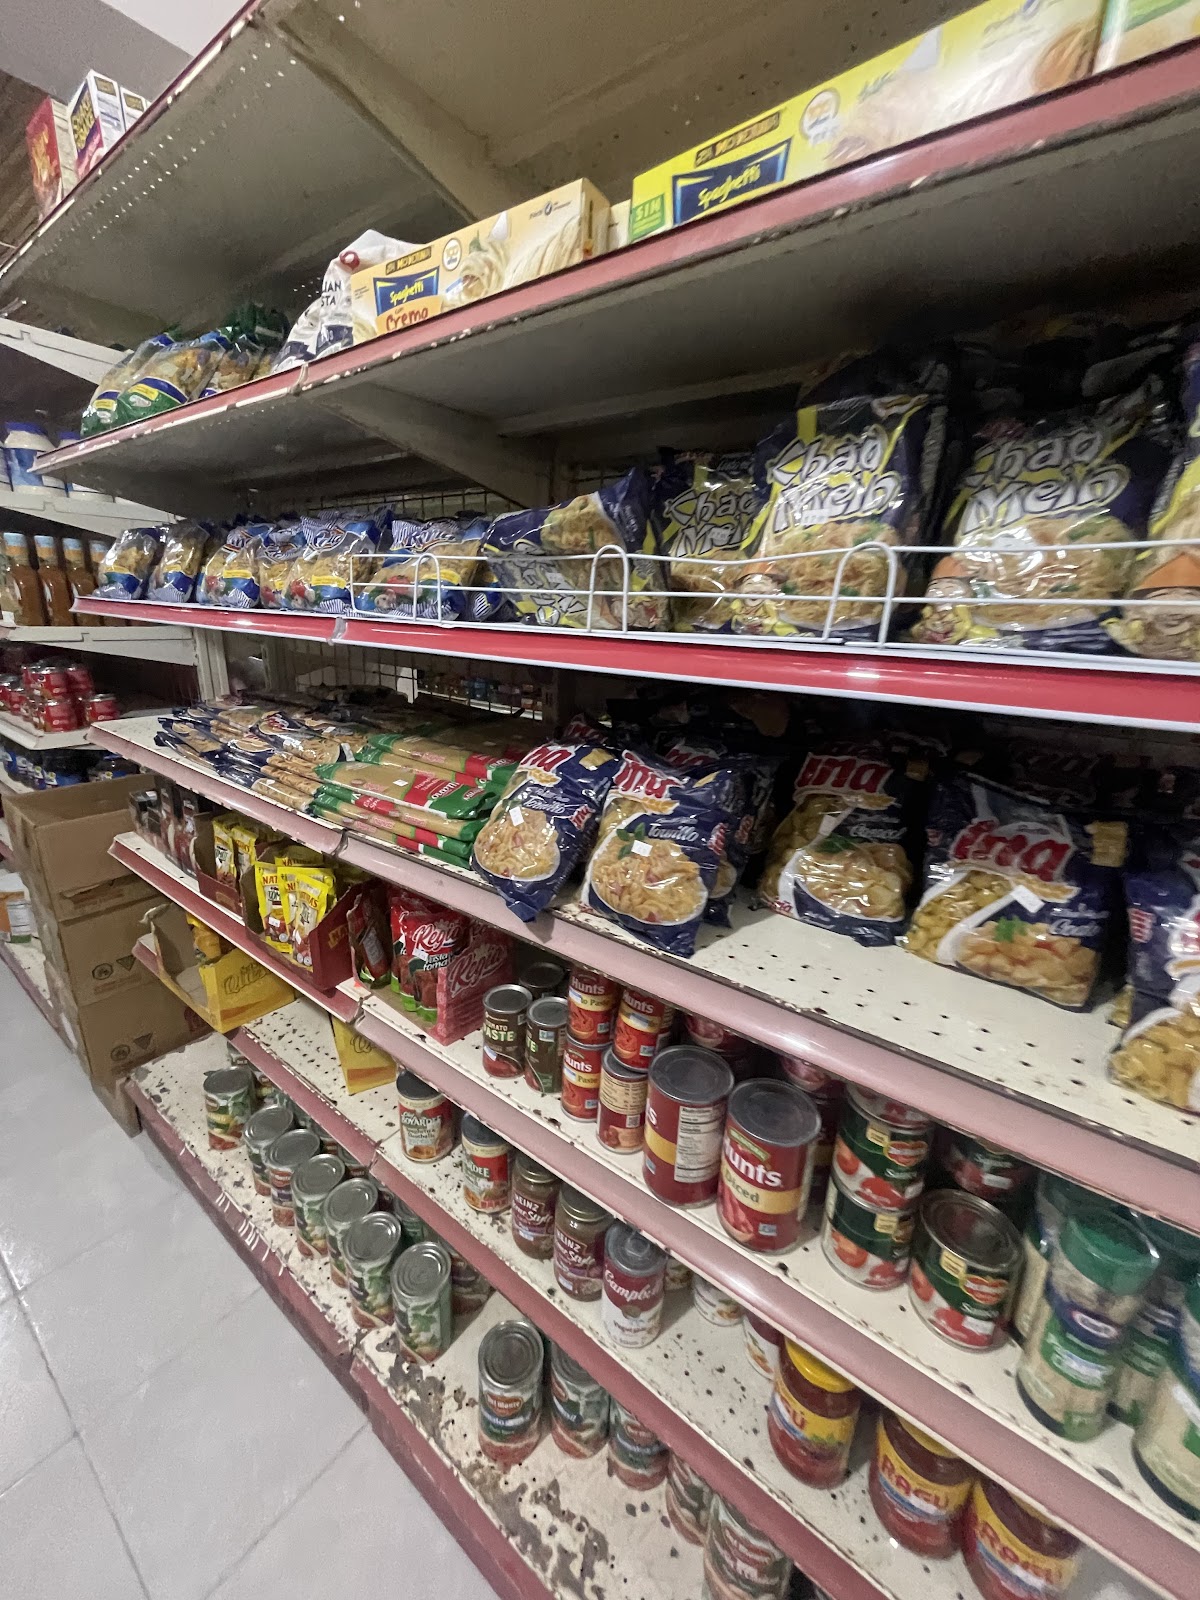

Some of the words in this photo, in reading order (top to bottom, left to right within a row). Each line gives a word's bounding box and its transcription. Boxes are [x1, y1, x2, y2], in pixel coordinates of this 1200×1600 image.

[698, 164, 761, 210] Spaghetti
[390, 281, 424, 306] Spaghetti
[724, 1170, 760, 1205] Diced
